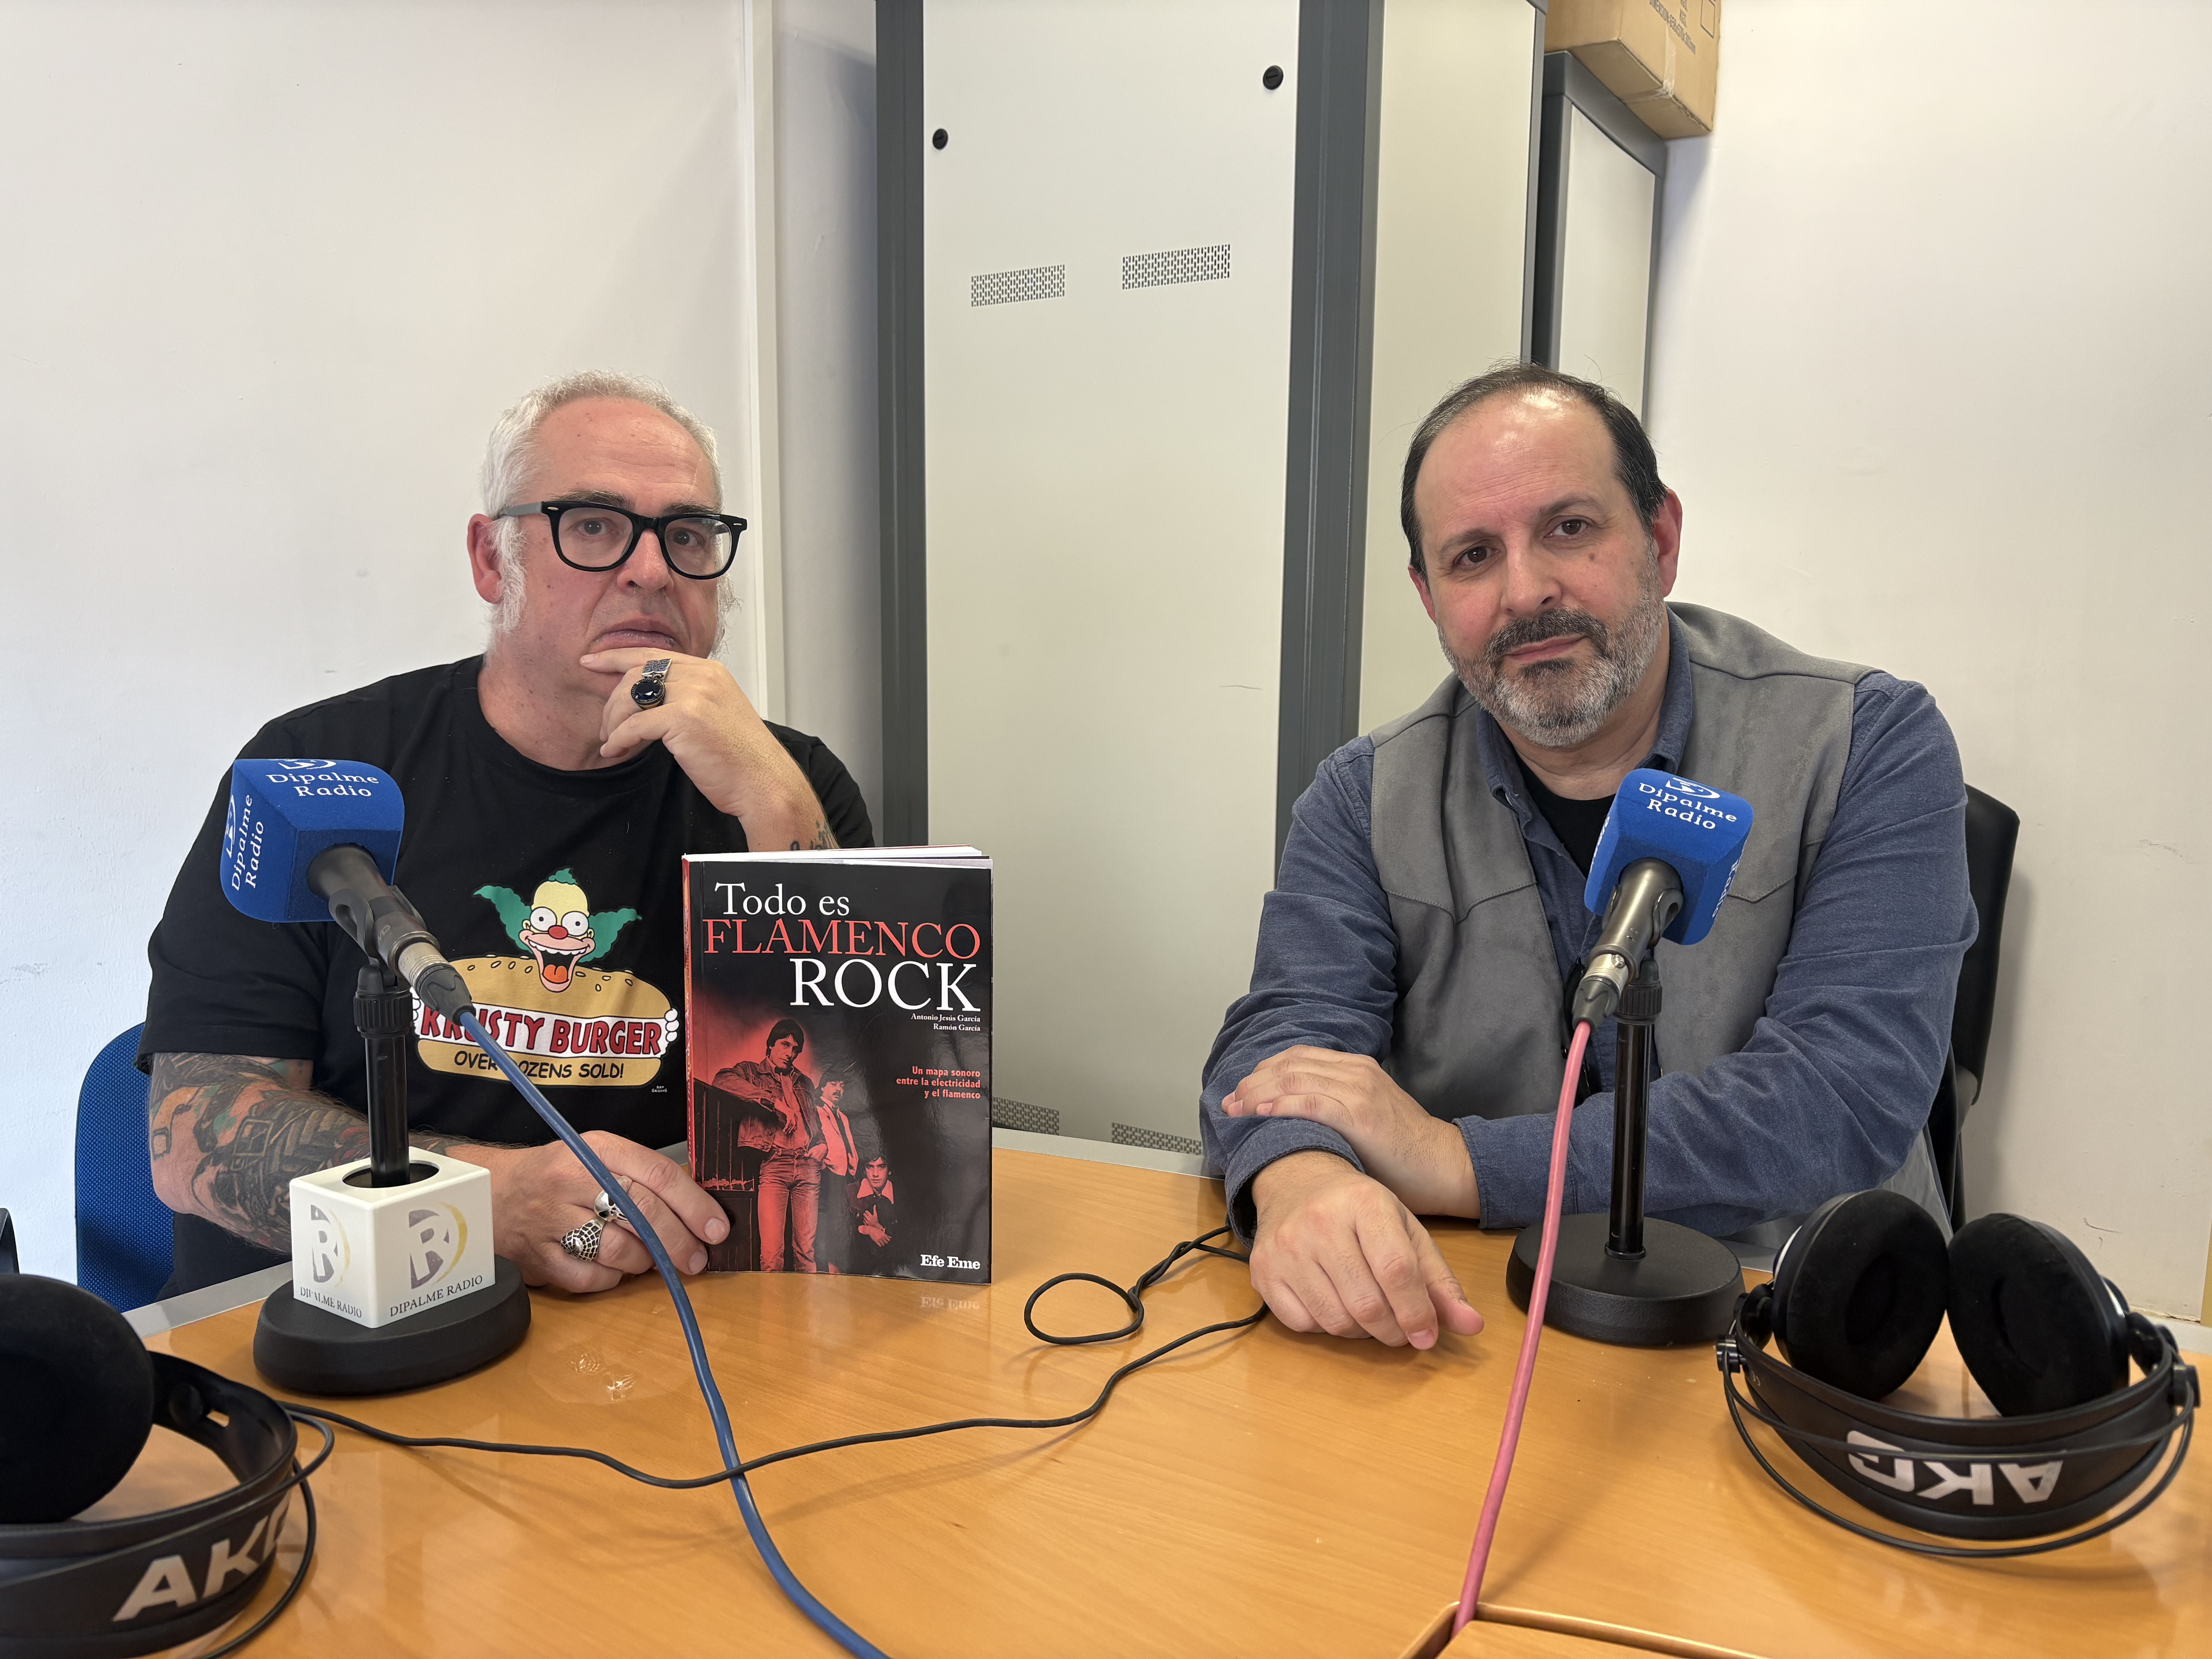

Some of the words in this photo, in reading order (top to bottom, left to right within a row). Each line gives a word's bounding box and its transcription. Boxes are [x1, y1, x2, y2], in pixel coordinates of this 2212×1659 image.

[266, 772, 379, 784] Dipalme
[294, 785, 372, 797] Radio
[1639, 783, 1737, 822] Dipalme
[1647, 799, 1716, 829] Radio
[232, 795, 252, 891] Dipalme
[246, 821, 264, 888] Radio
[714, 882, 806, 915] Todo
[819, 895, 850, 916] es
[702, 918, 980, 959] FLAMENCO
[790, 958, 981, 1012] ROCK
[550, 1019, 661, 1055] BURGER
[454, 1051, 498, 1071] OVER
[518, 1060, 572, 1079] OZENS
[579, 1063, 624, 1079] SOLD!
[912, 1066, 923, 1074] Un
[926, 1069, 948, 1078] mapa
[921, 1077, 929, 1085] la
[931, 1078, 981, 1088] electricidad
[924, 1090, 929, 1099] y
[942, 1089, 981, 1099] flamenco
[920, 1254, 945, 1267] Efe
[947, 1256, 981, 1269] Eme
[337, 1300, 362, 1318] RADIO
[390, 1289, 444, 1317] DIPALME
[447, 1275, 483, 1296] RADIO
[1847, 1430, 2064, 1505] AKG
